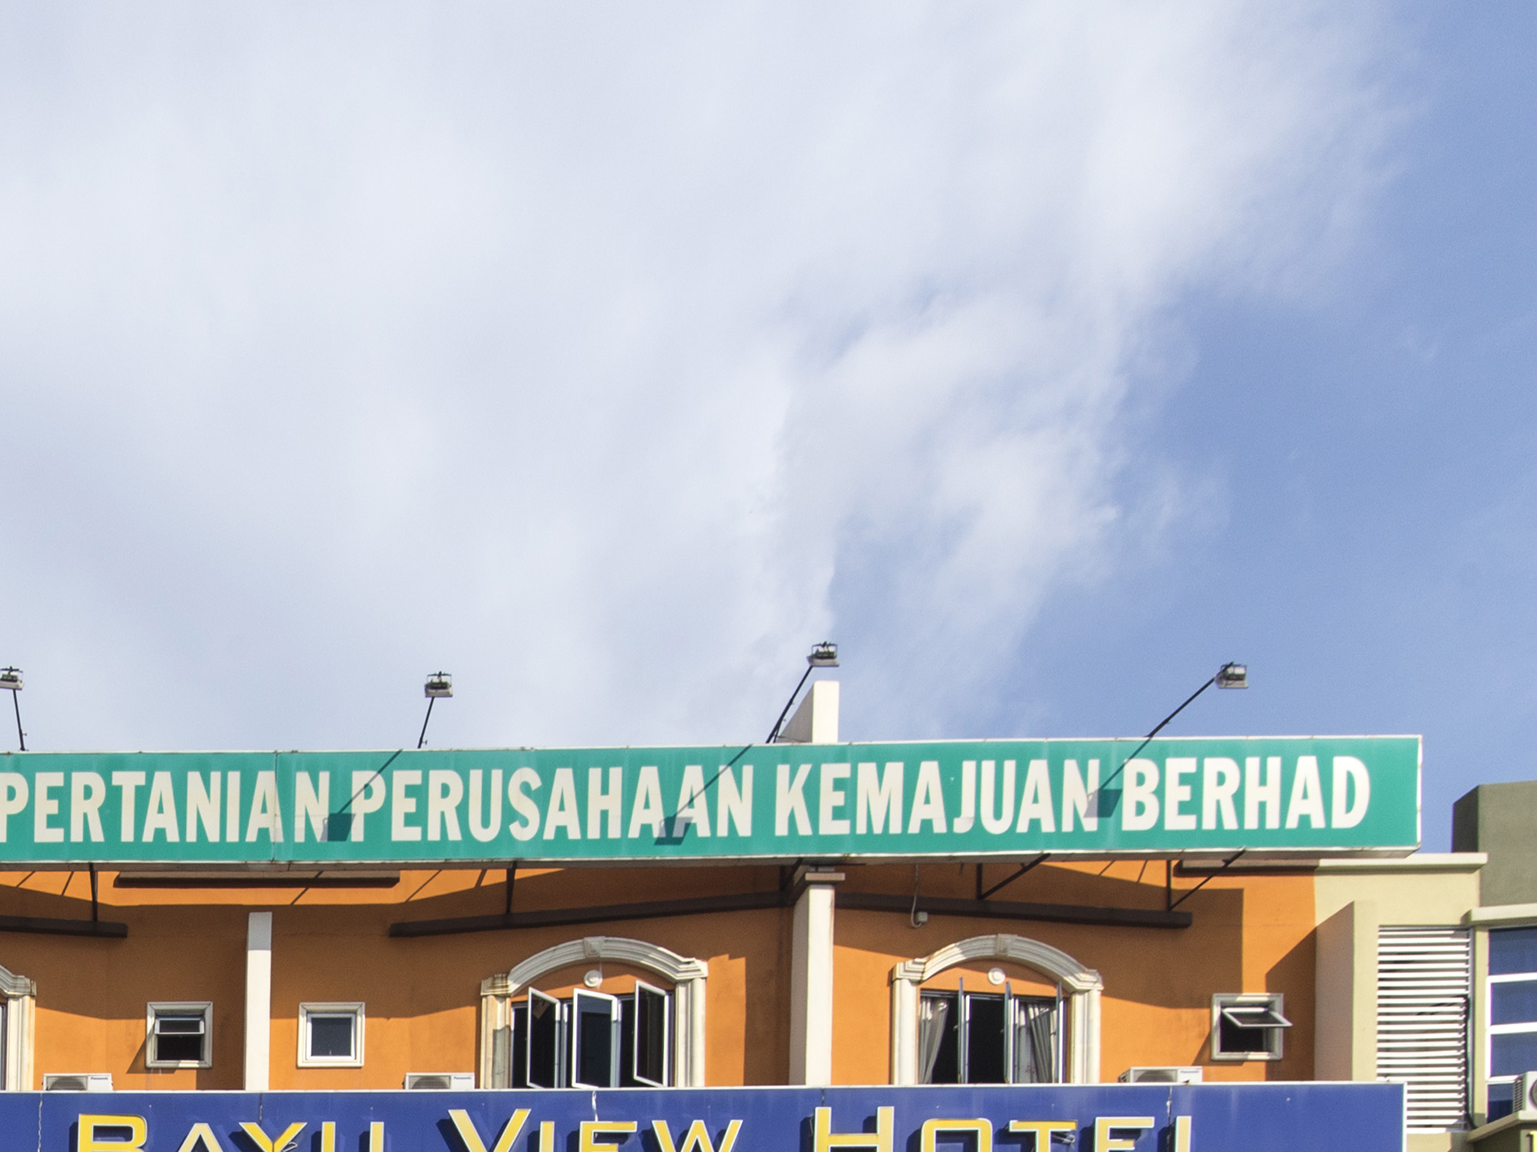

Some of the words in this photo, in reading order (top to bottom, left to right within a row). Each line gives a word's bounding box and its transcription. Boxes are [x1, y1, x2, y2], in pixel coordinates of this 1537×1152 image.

[350, 764, 755, 842] PERUSAHAAN
[774, 760, 1101, 837] KEMAJUAN
[1121, 756, 1372, 832] BERHAD
